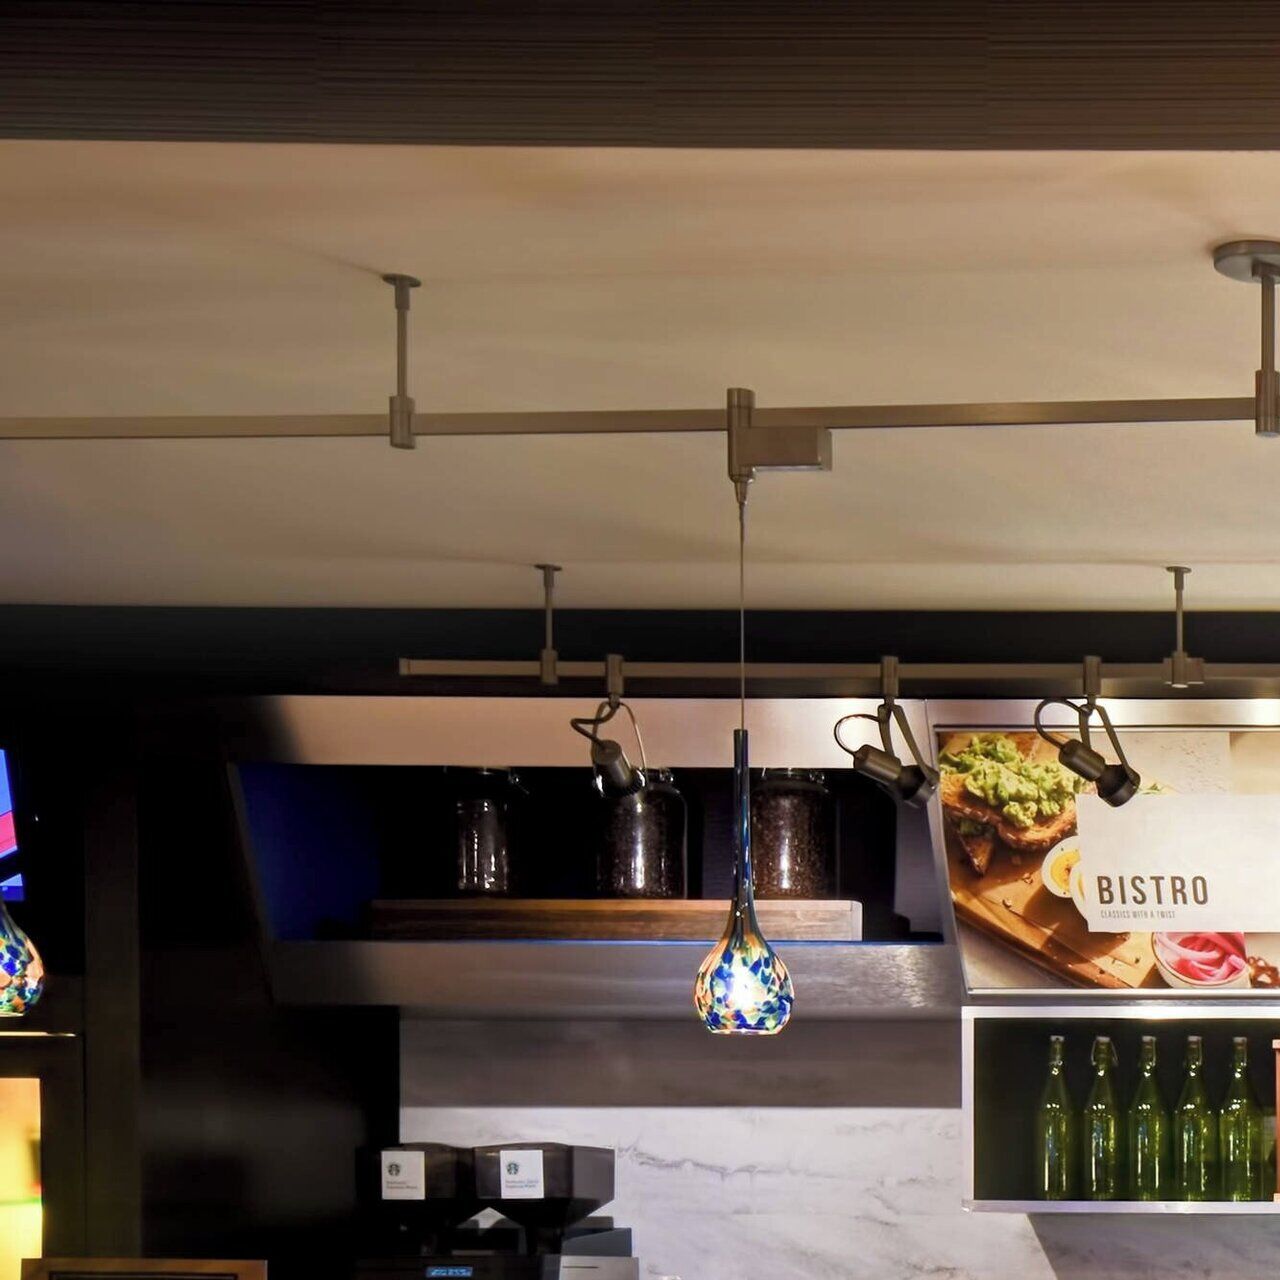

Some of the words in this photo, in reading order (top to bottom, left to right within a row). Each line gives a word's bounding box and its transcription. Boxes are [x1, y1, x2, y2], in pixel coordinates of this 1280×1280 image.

[1097, 875, 1209, 905] BISTRO
[1100, 910, 1131, 919] CLASSICS
[1132, 911, 1150, 919] WITH
[1158, 911, 1176, 919] TWIST
